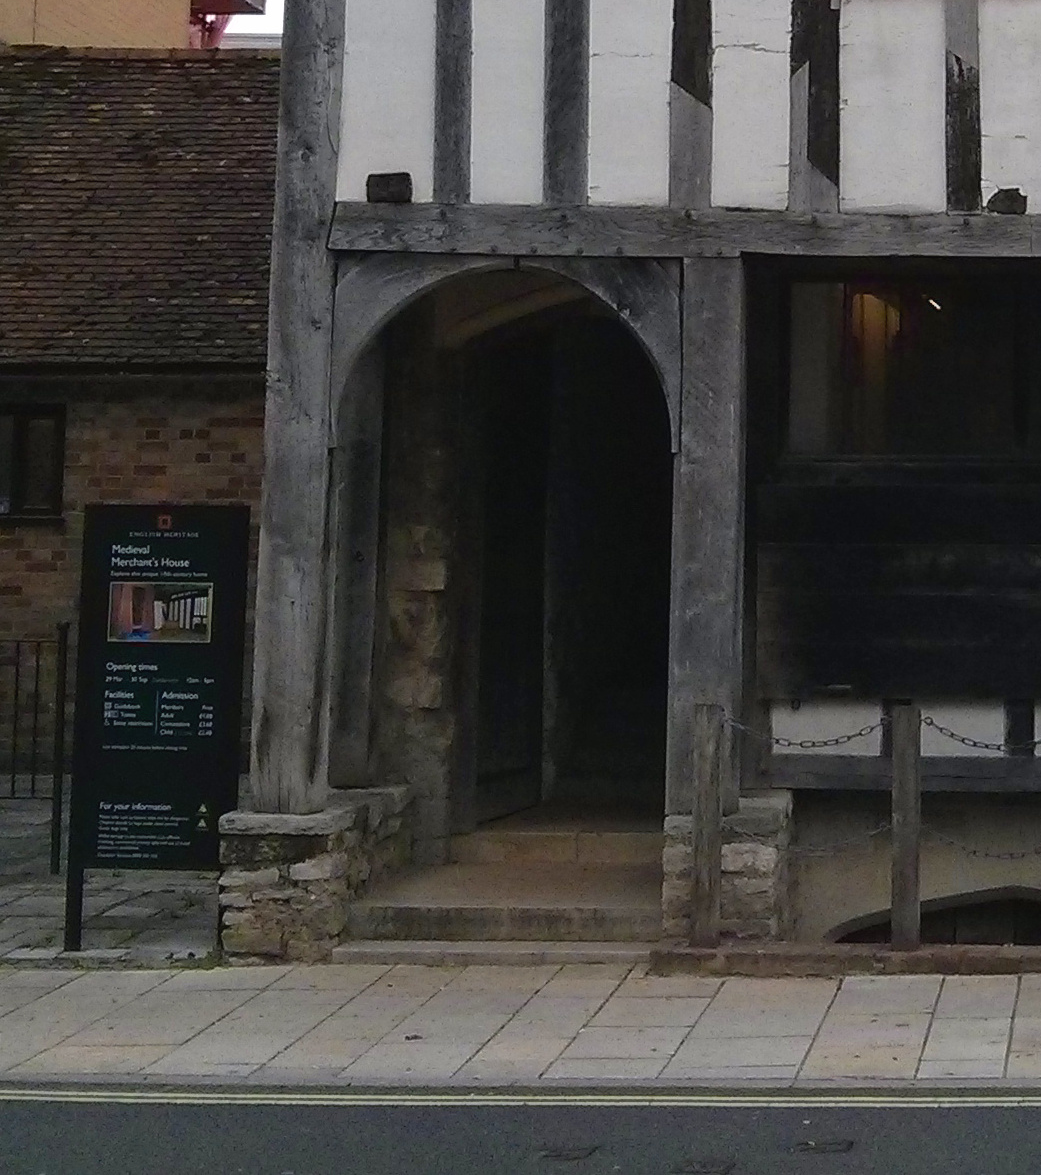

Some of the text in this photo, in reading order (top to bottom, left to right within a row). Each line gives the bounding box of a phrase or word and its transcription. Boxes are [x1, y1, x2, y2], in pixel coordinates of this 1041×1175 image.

[112, 544, 150, 554] Medieval
[111, 557, 190, 568] Merchant's House
[106, 662, 158, 672] Opening times
[104, 690, 134, 699] Facilities
[161, 691, 199, 700] Admission
[99, 802, 172, 812] For your information
